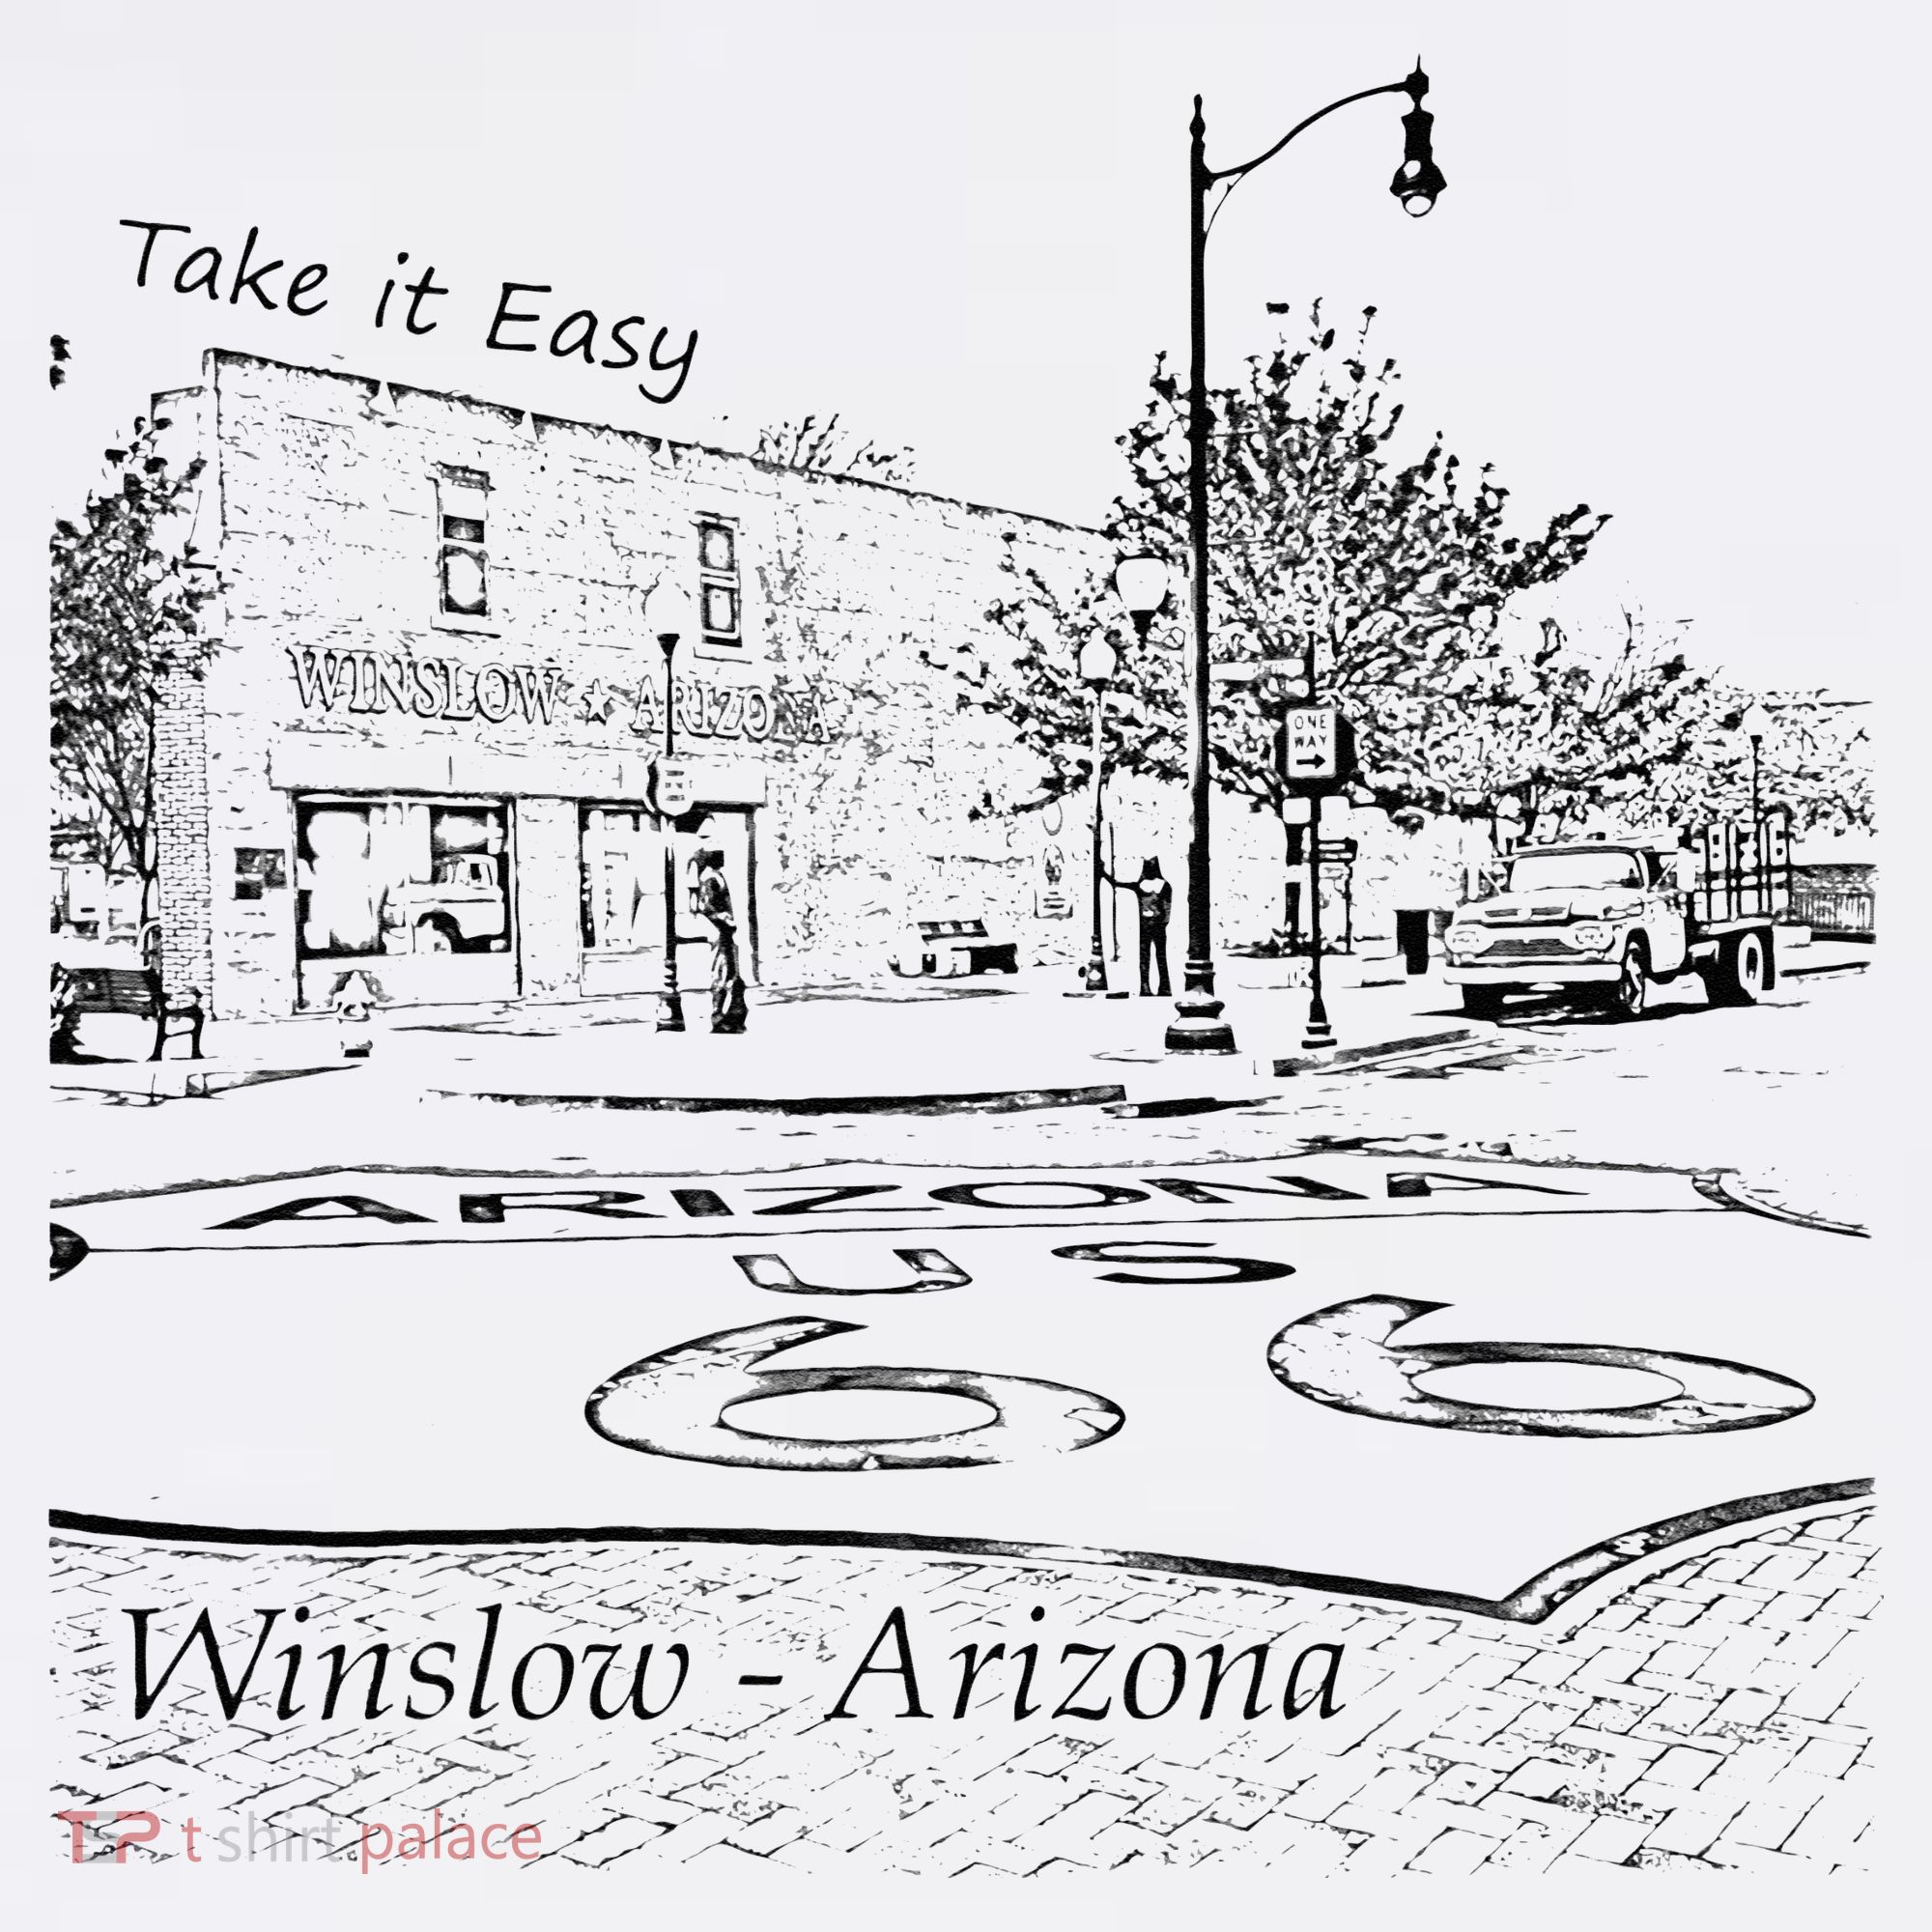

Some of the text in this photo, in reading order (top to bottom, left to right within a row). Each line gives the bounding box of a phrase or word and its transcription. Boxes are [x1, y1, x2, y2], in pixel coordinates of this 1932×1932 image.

[286, 645, 833, 744] WINSLOW ARIZONA
[1294, 714, 1327, 729] ONE
[1294, 734, 1327, 748] WAY
[203, 1172, 1590, 1231] ARIZONA
